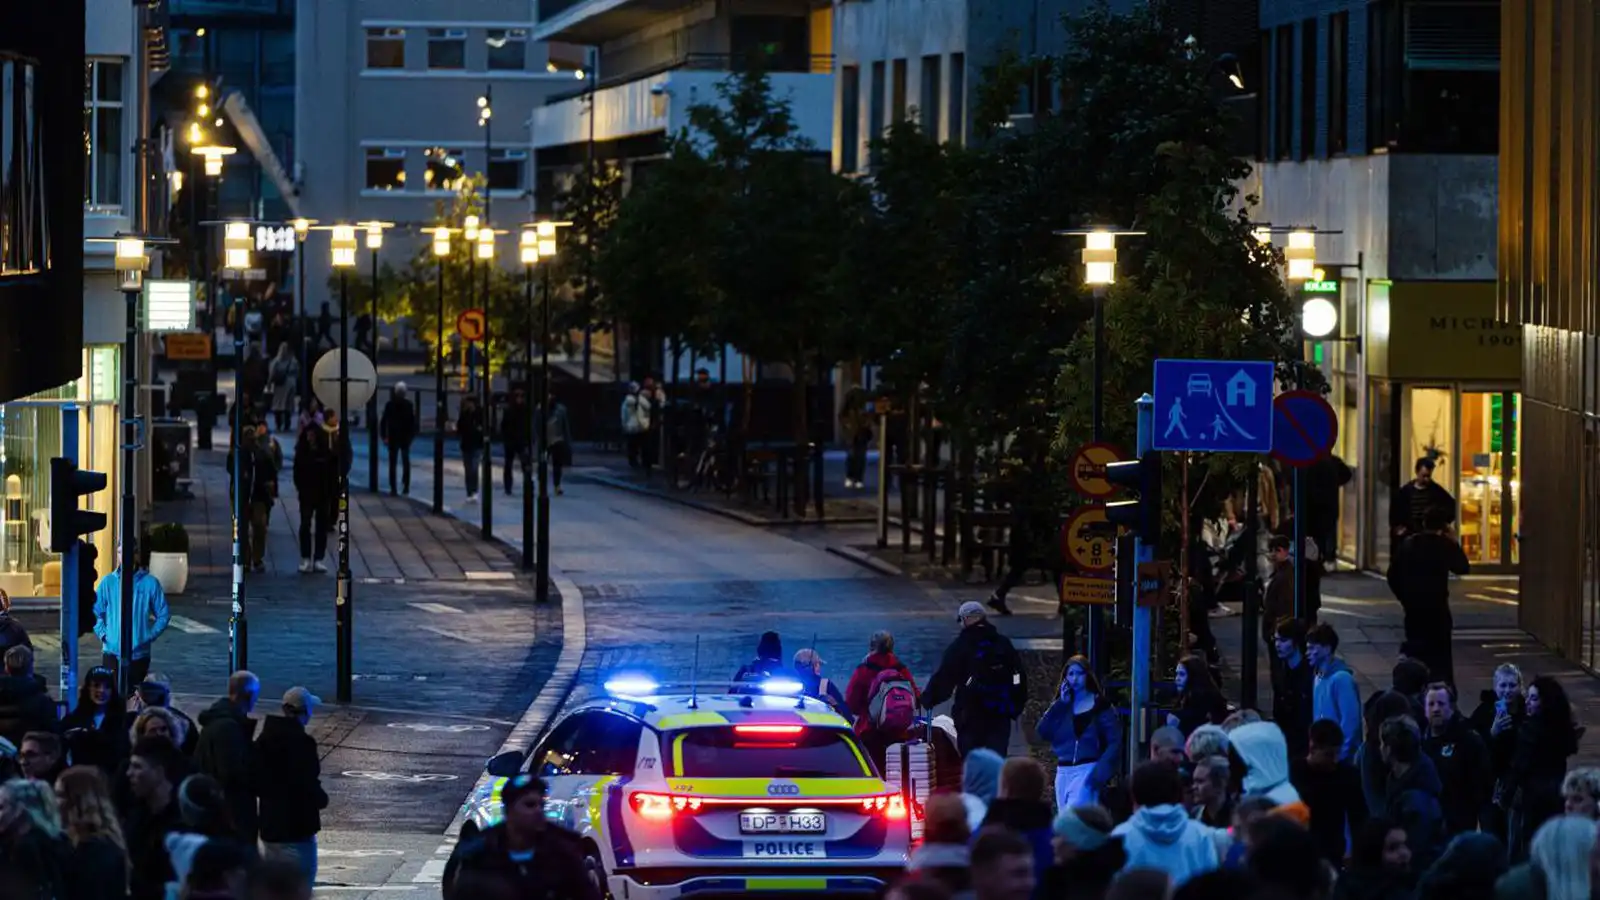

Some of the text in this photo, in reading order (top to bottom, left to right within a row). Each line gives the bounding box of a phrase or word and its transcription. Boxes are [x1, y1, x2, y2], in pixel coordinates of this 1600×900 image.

[1092, 543, 1102, 556] 8
[1090, 557, 1102, 566] m
[753, 816, 777, 830] DP
[790, 816, 822, 830] H33
[755, 842, 814, 856] POLICE
